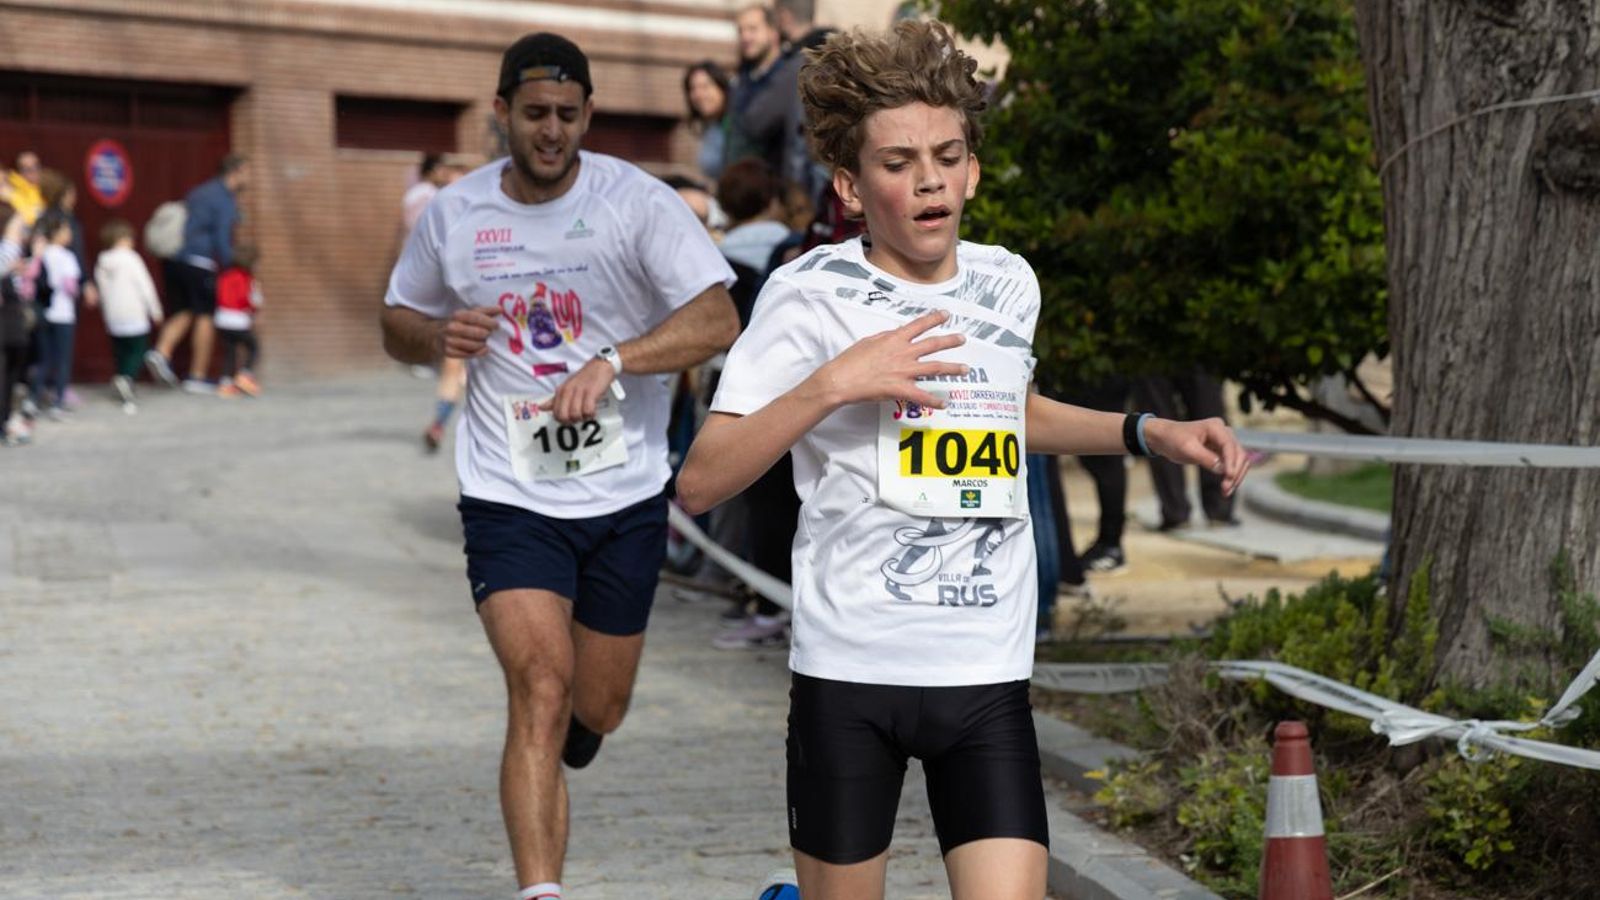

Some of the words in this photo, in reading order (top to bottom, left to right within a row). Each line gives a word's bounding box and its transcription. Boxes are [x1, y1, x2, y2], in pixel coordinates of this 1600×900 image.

[475, 228, 512, 244] XXVII
[948, 390, 969, 400] XXVII
[533, 420, 603, 453] 102
[899, 431, 1020, 477] 1040
[953, 480, 988, 488] MARCOS
[938, 573, 962, 583] VILLA
[938, 584, 998, 607] RUS
